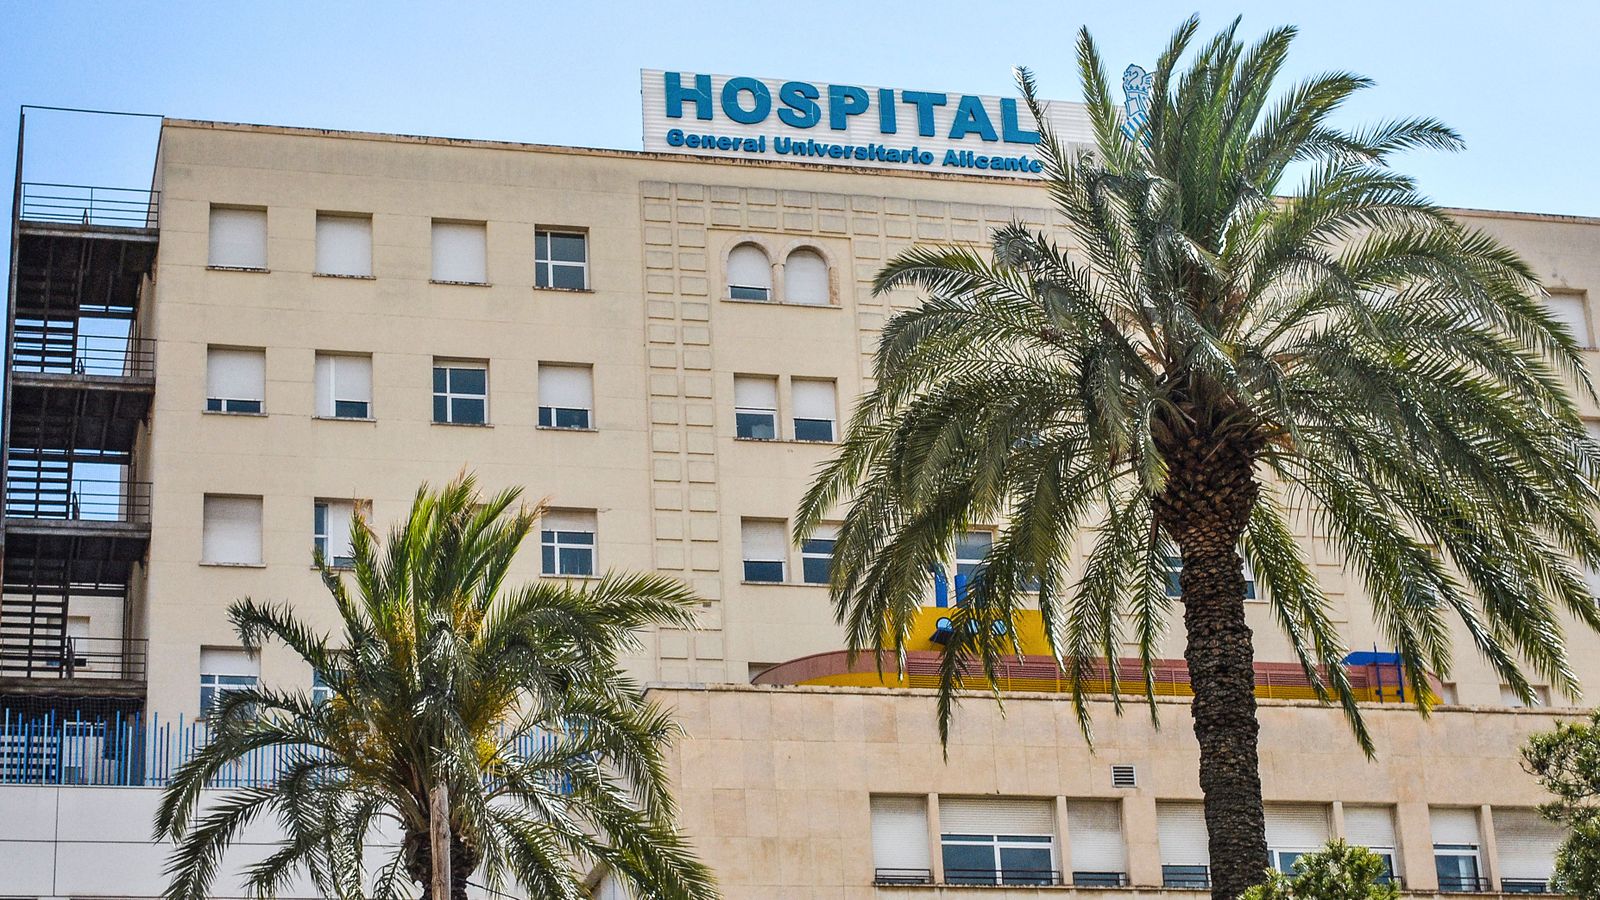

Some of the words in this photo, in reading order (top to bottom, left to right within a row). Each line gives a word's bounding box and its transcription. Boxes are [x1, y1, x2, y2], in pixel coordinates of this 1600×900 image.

[664, 72, 1041, 144] HOSPITAL
[666, 129, 766, 153] General
[774, 136, 934, 165] Universitario
[943, 149, 1043, 173] Alicante
